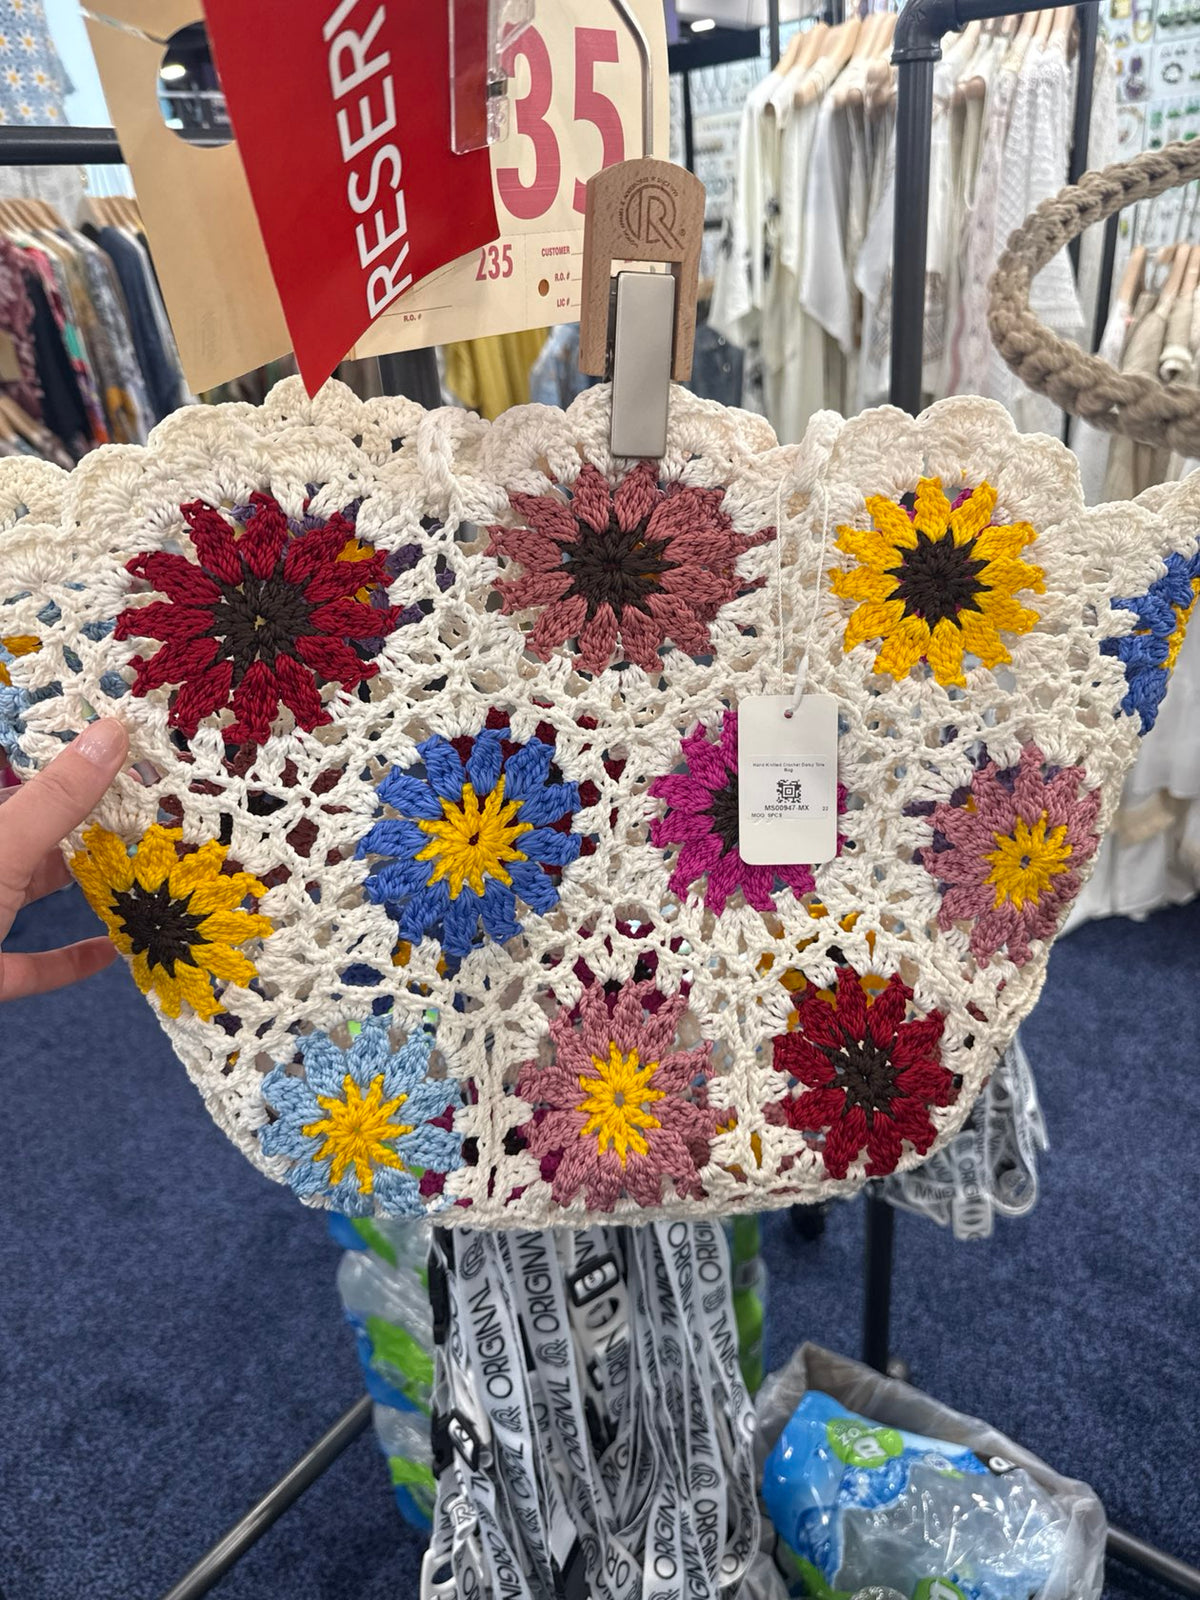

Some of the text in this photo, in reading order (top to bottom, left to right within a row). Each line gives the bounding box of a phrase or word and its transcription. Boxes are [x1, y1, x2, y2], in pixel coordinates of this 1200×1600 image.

[541, 245, 571, 258] CUSTOMER
[556, 299, 566, 308] LIC
[516, 1231, 560, 1334] ORIGINA
[667, 1222, 695, 1326] ORIGINA
[468, 1277, 514, 1399] ORIGINAL
[547, 1376, 587, 1474] ORIGINAL
[653, 1483, 677, 1580] ORIGINA
[694, 1498, 718, 1583] ORIGINA
